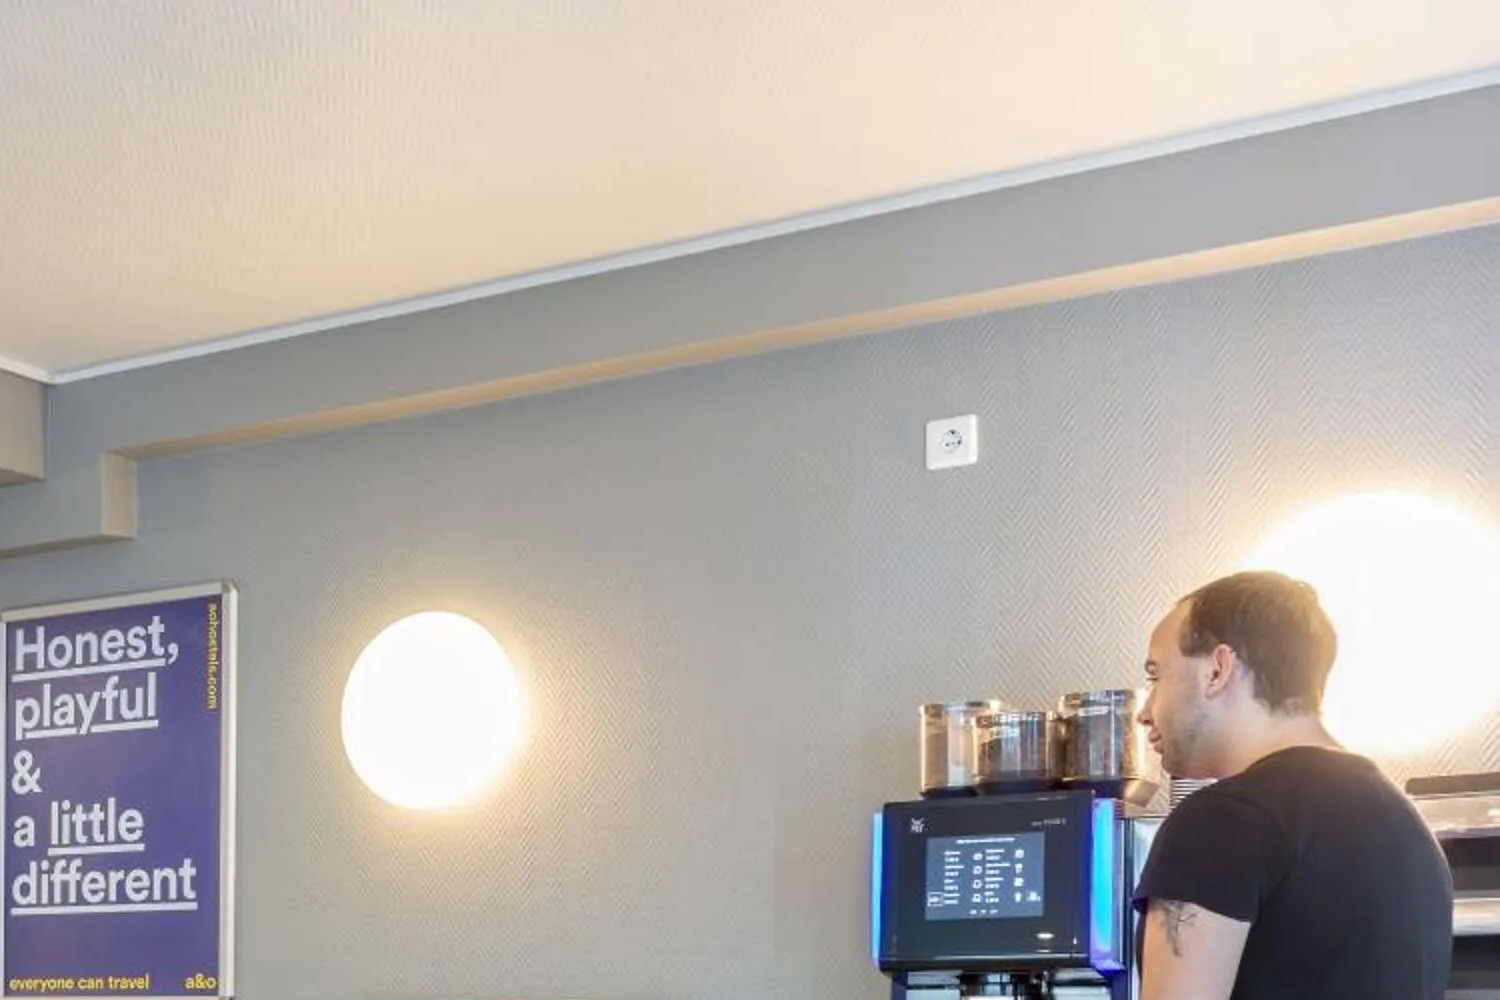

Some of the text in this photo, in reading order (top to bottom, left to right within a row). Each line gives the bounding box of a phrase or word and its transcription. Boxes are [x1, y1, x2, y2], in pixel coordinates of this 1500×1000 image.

[15, 616, 179, 672] Honest,
[15, 672, 157, 740] playful
[11, 750, 42, 794] &
[13, 797, 145, 847] a little
[11, 858, 197, 905] different
[9, 972, 150, 993] everyone can travel
[184, 973, 217, 990] a&o
